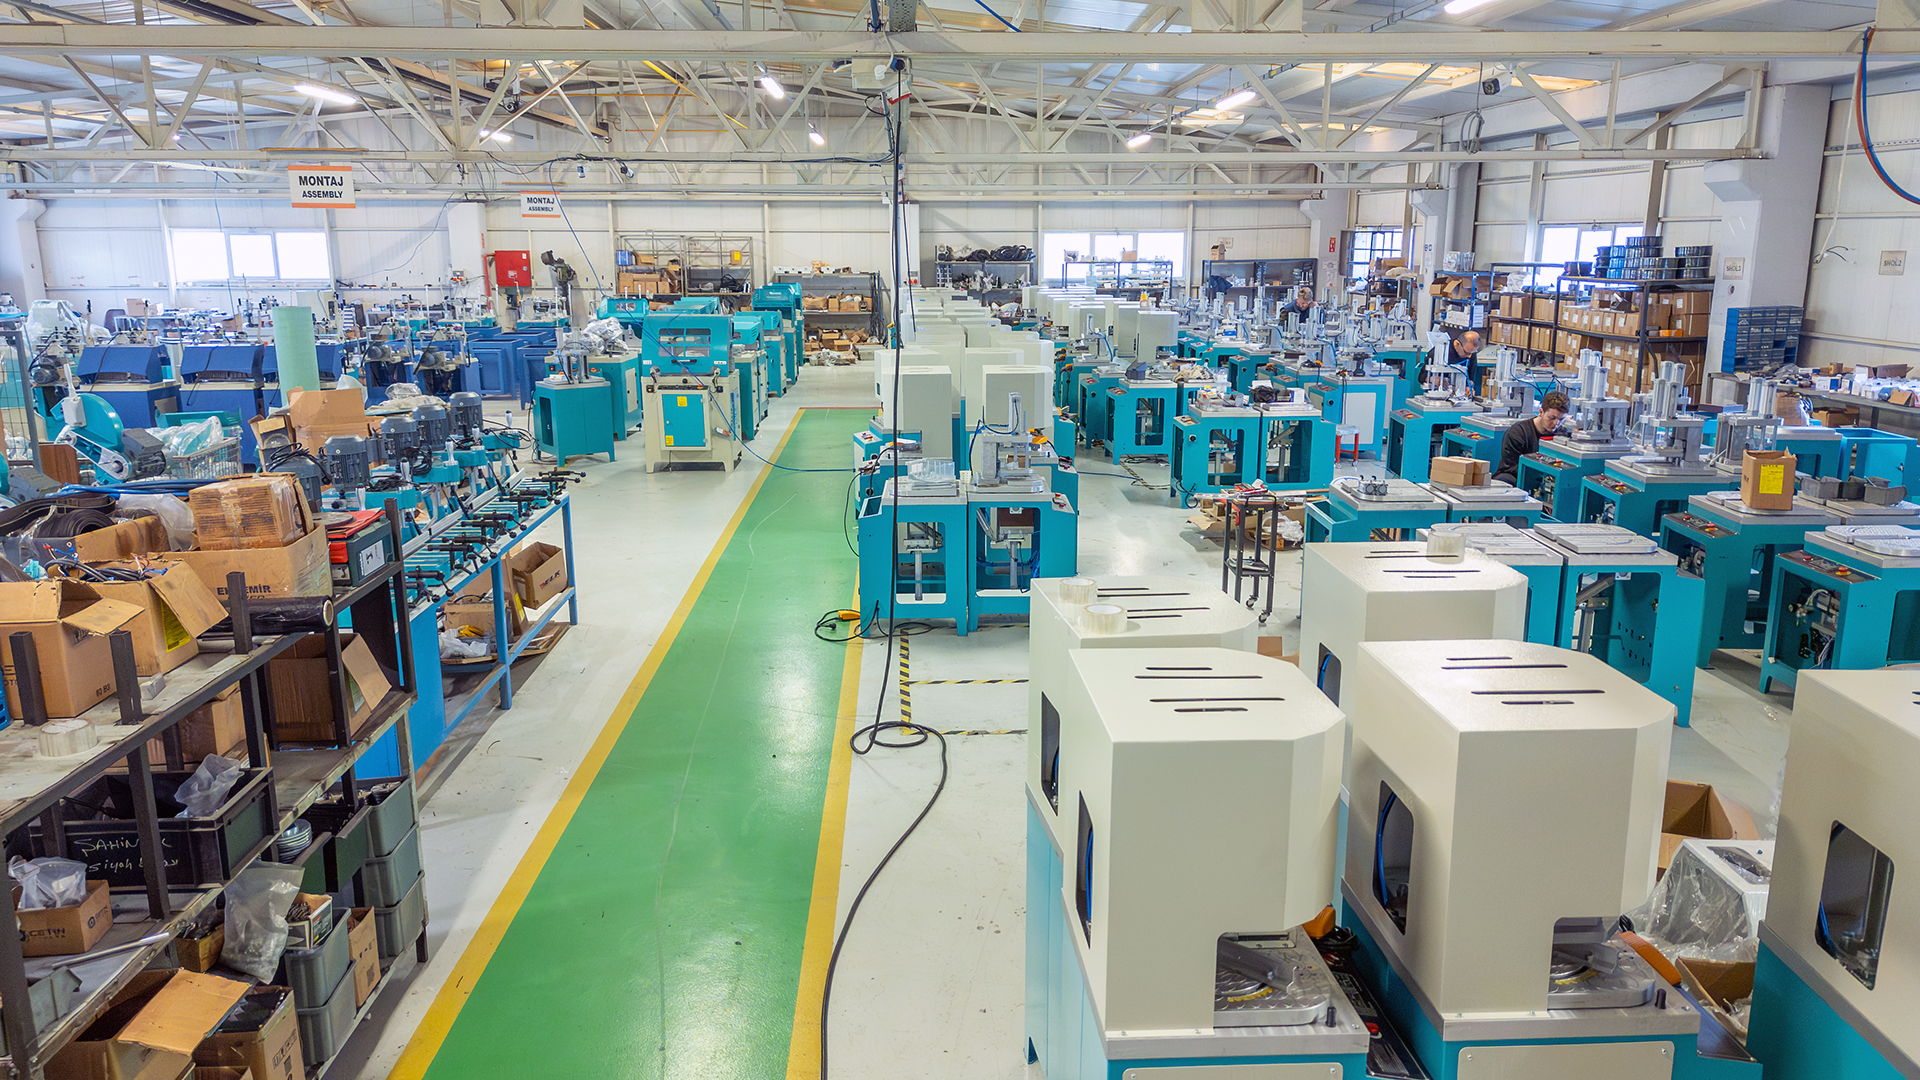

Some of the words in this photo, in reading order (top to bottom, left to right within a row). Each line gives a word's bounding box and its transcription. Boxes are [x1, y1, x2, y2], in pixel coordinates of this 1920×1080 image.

[298, 175, 344, 187] MONTAJ
[302, 190, 343, 199] ASSEMBLY
[526, 197, 555, 205] MONTAJ
